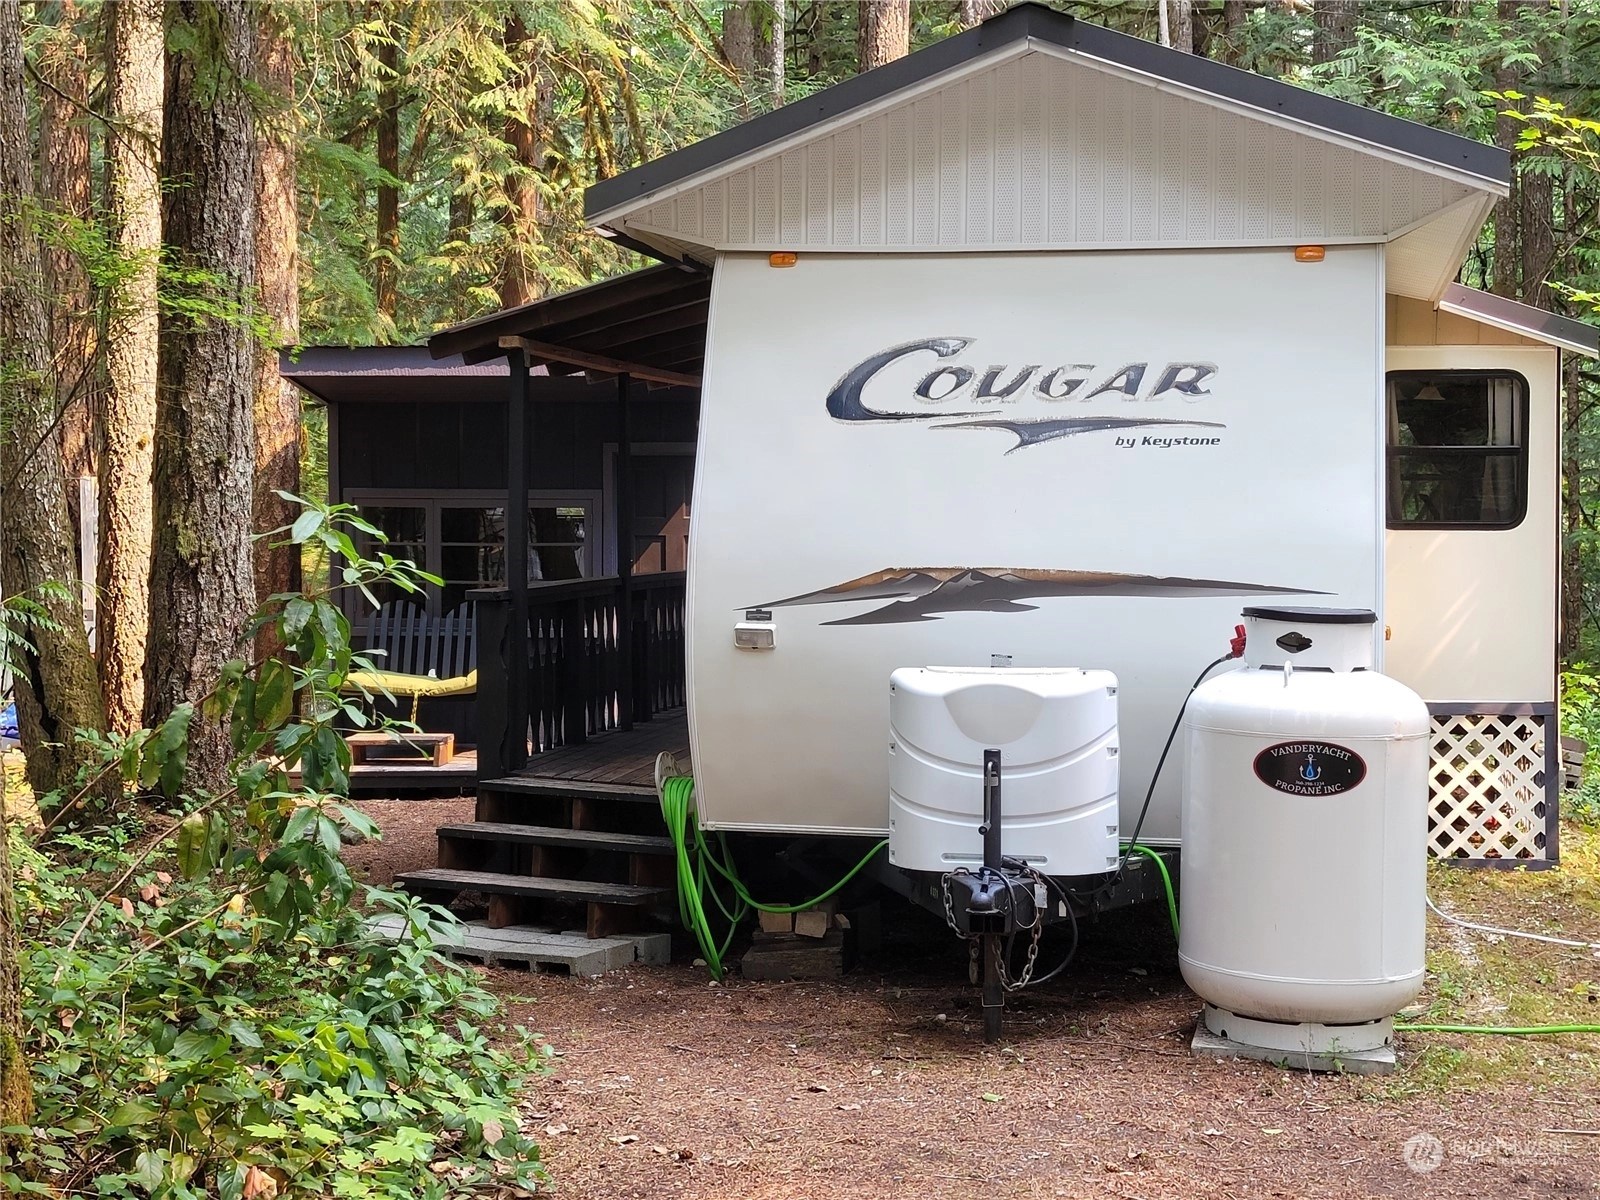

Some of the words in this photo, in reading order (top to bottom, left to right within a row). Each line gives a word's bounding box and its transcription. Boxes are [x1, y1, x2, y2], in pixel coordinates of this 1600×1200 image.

[826, 336, 1219, 424] COUGAR
[1115, 436, 1136, 449] by
[1141, 435, 1221, 449] Keystone
[1270, 743, 1352, 761] VANDERYACHT
[1275, 779, 1322, 795] PROPANE
[1324, 783, 1345, 794] INC.
